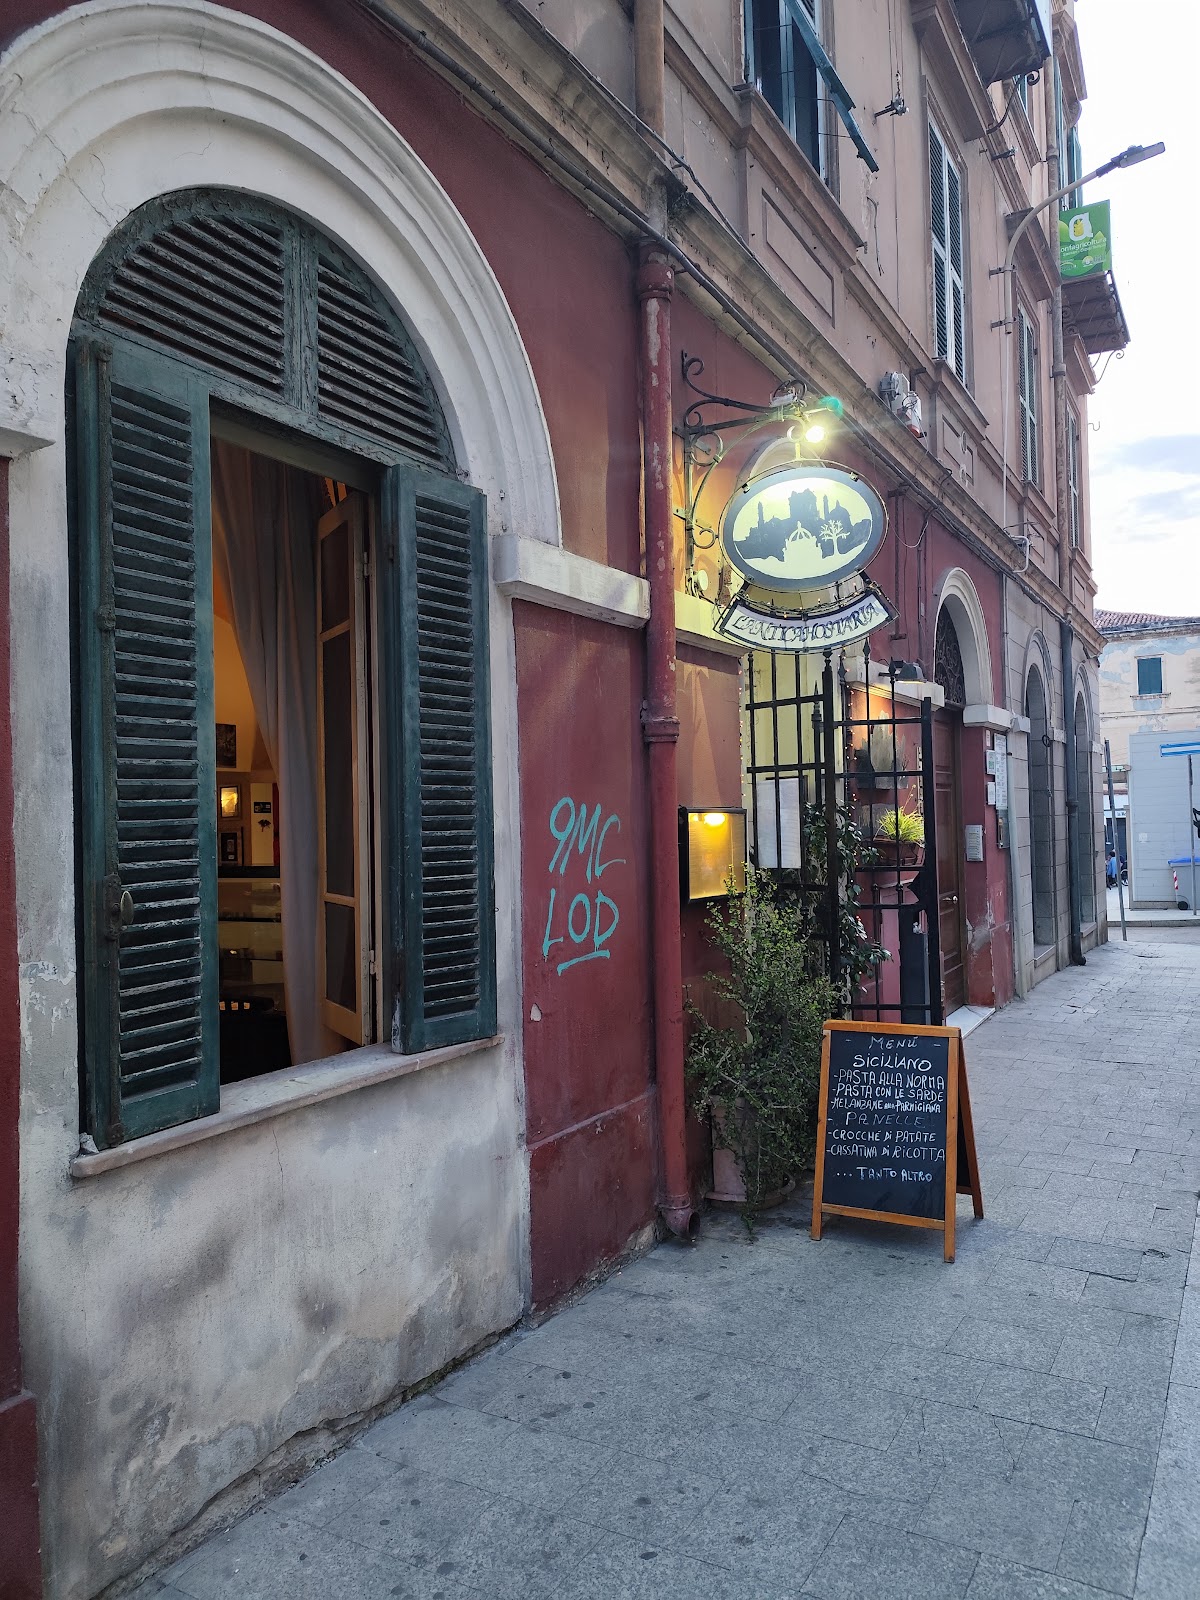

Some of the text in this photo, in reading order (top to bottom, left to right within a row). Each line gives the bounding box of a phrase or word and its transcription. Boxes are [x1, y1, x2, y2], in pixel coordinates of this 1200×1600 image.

[1060, 237, 1107, 253] onfagricoltura
[879, 1071, 903, 1088] ALLA
[906, 1073, 945, 1090] NORMA
[875, 1086, 892, 1098] CON
[895, 1088, 905, 1099] LE
[908, 1089, 944, 1104] SARDE
[845, 1111, 926, 1129] PANELLE
[895, 1130, 936, 1143] PATATE
[856, 1166, 898, 1181] TANTO
[901, 1168, 933, 1183] ALTRO
